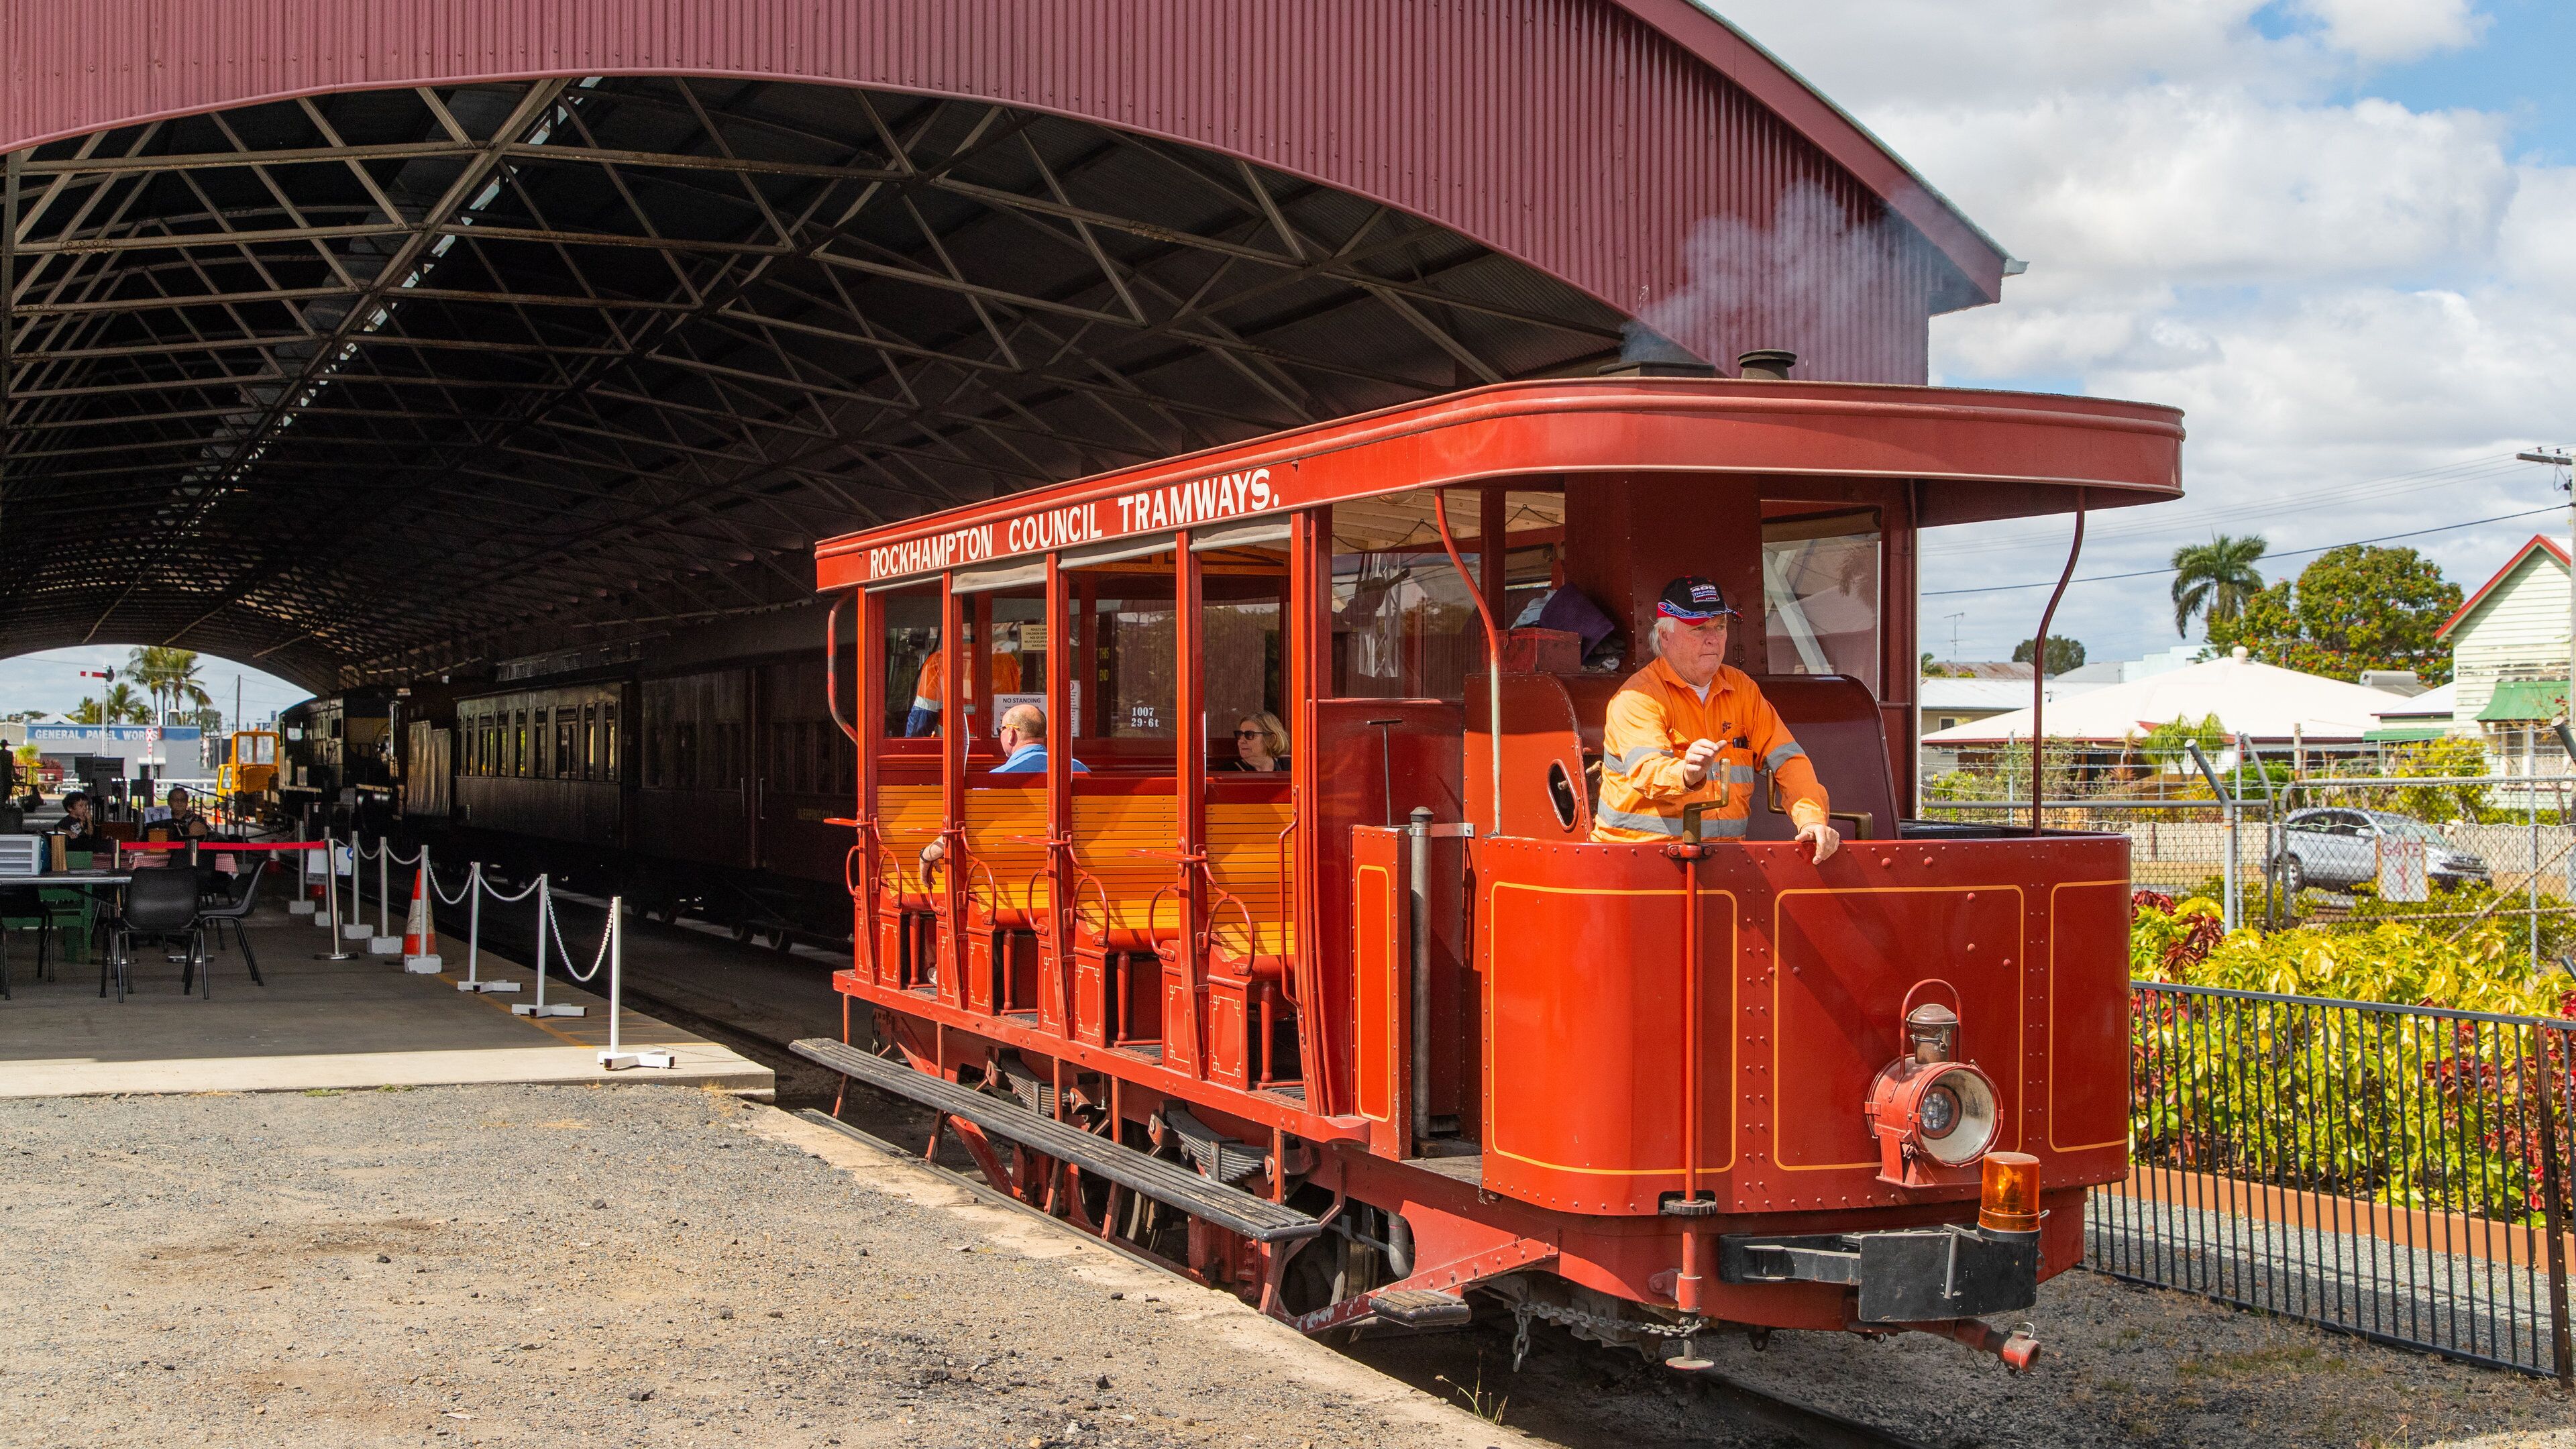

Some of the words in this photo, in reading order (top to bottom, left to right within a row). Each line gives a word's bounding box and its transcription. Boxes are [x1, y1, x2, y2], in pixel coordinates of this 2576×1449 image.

[870, 524, 993, 580] ROCKHAMPTON
[1008, 503, 1102, 552] COUNCIL
[1118, 468, 1279, 533] TRAMWAYS.
[1132, 706, 1155, 717] 1007
[35, 729, 80, 740] GENERAL
